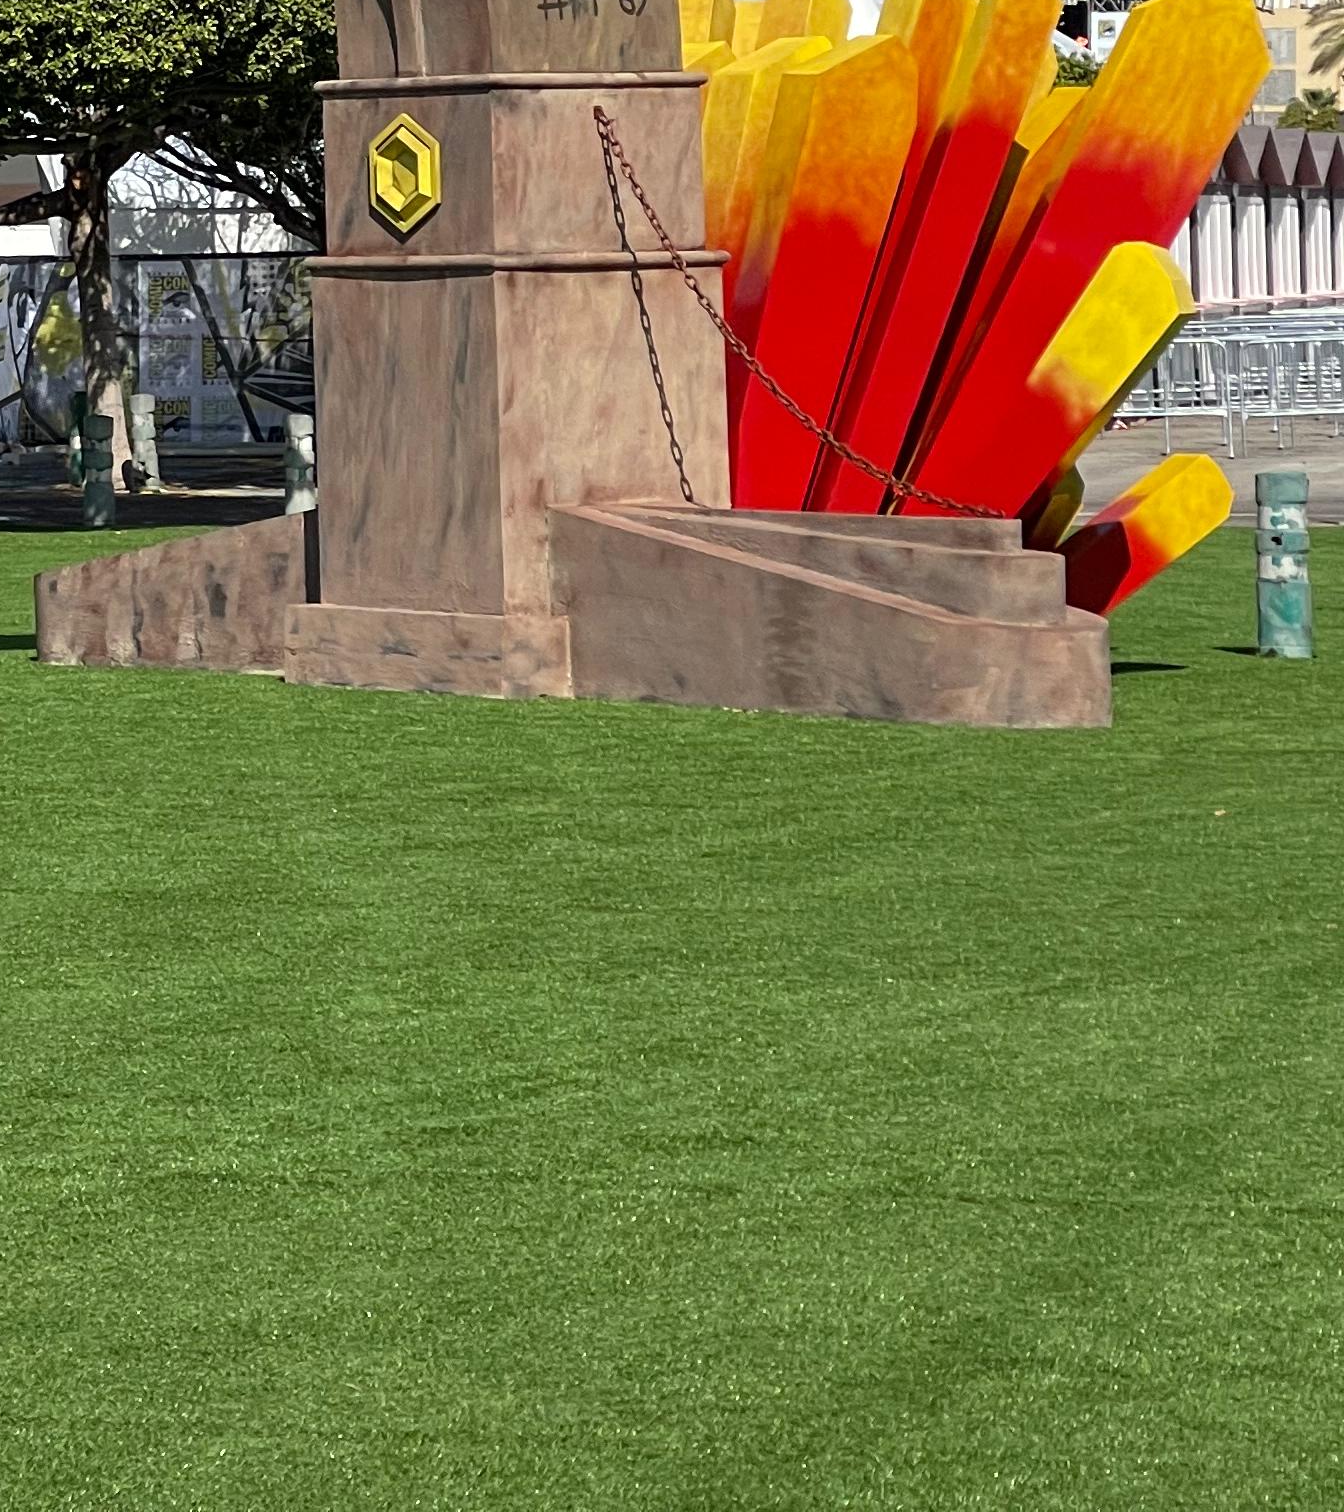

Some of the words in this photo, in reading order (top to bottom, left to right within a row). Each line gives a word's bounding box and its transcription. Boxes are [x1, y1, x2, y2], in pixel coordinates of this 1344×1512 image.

[163, 277, 190, 290] CON
[203, 339, 217, 378] COMIC
[164, 401, 190, 414] CON
